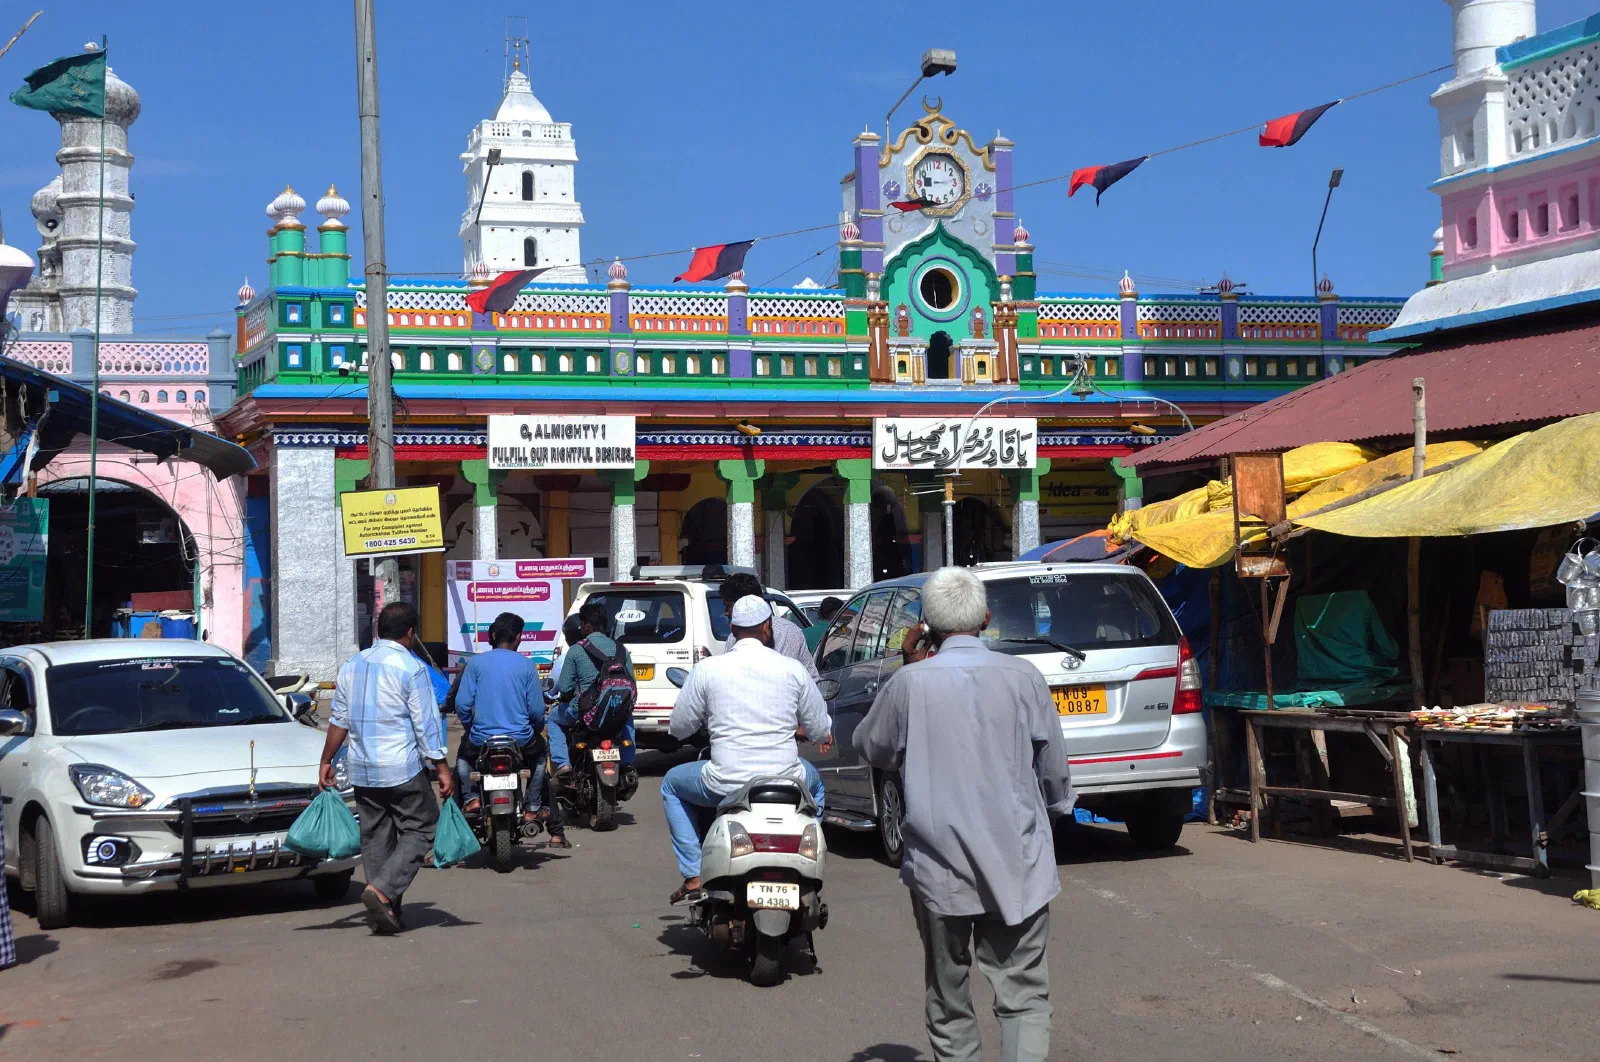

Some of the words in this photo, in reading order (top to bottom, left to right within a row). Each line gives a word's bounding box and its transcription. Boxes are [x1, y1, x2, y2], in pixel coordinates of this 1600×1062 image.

[493, 447, 528, 463] FULFILL
[530, 447, 549, 463] OUR
[551, 447, 593, 463] RIGHTFUL
[398, 537, 416, 545] 5430
[760, 885, 772, 893] TN
[776, 886, 788, 894] 76
[766, 898, 790, 907] 4383
